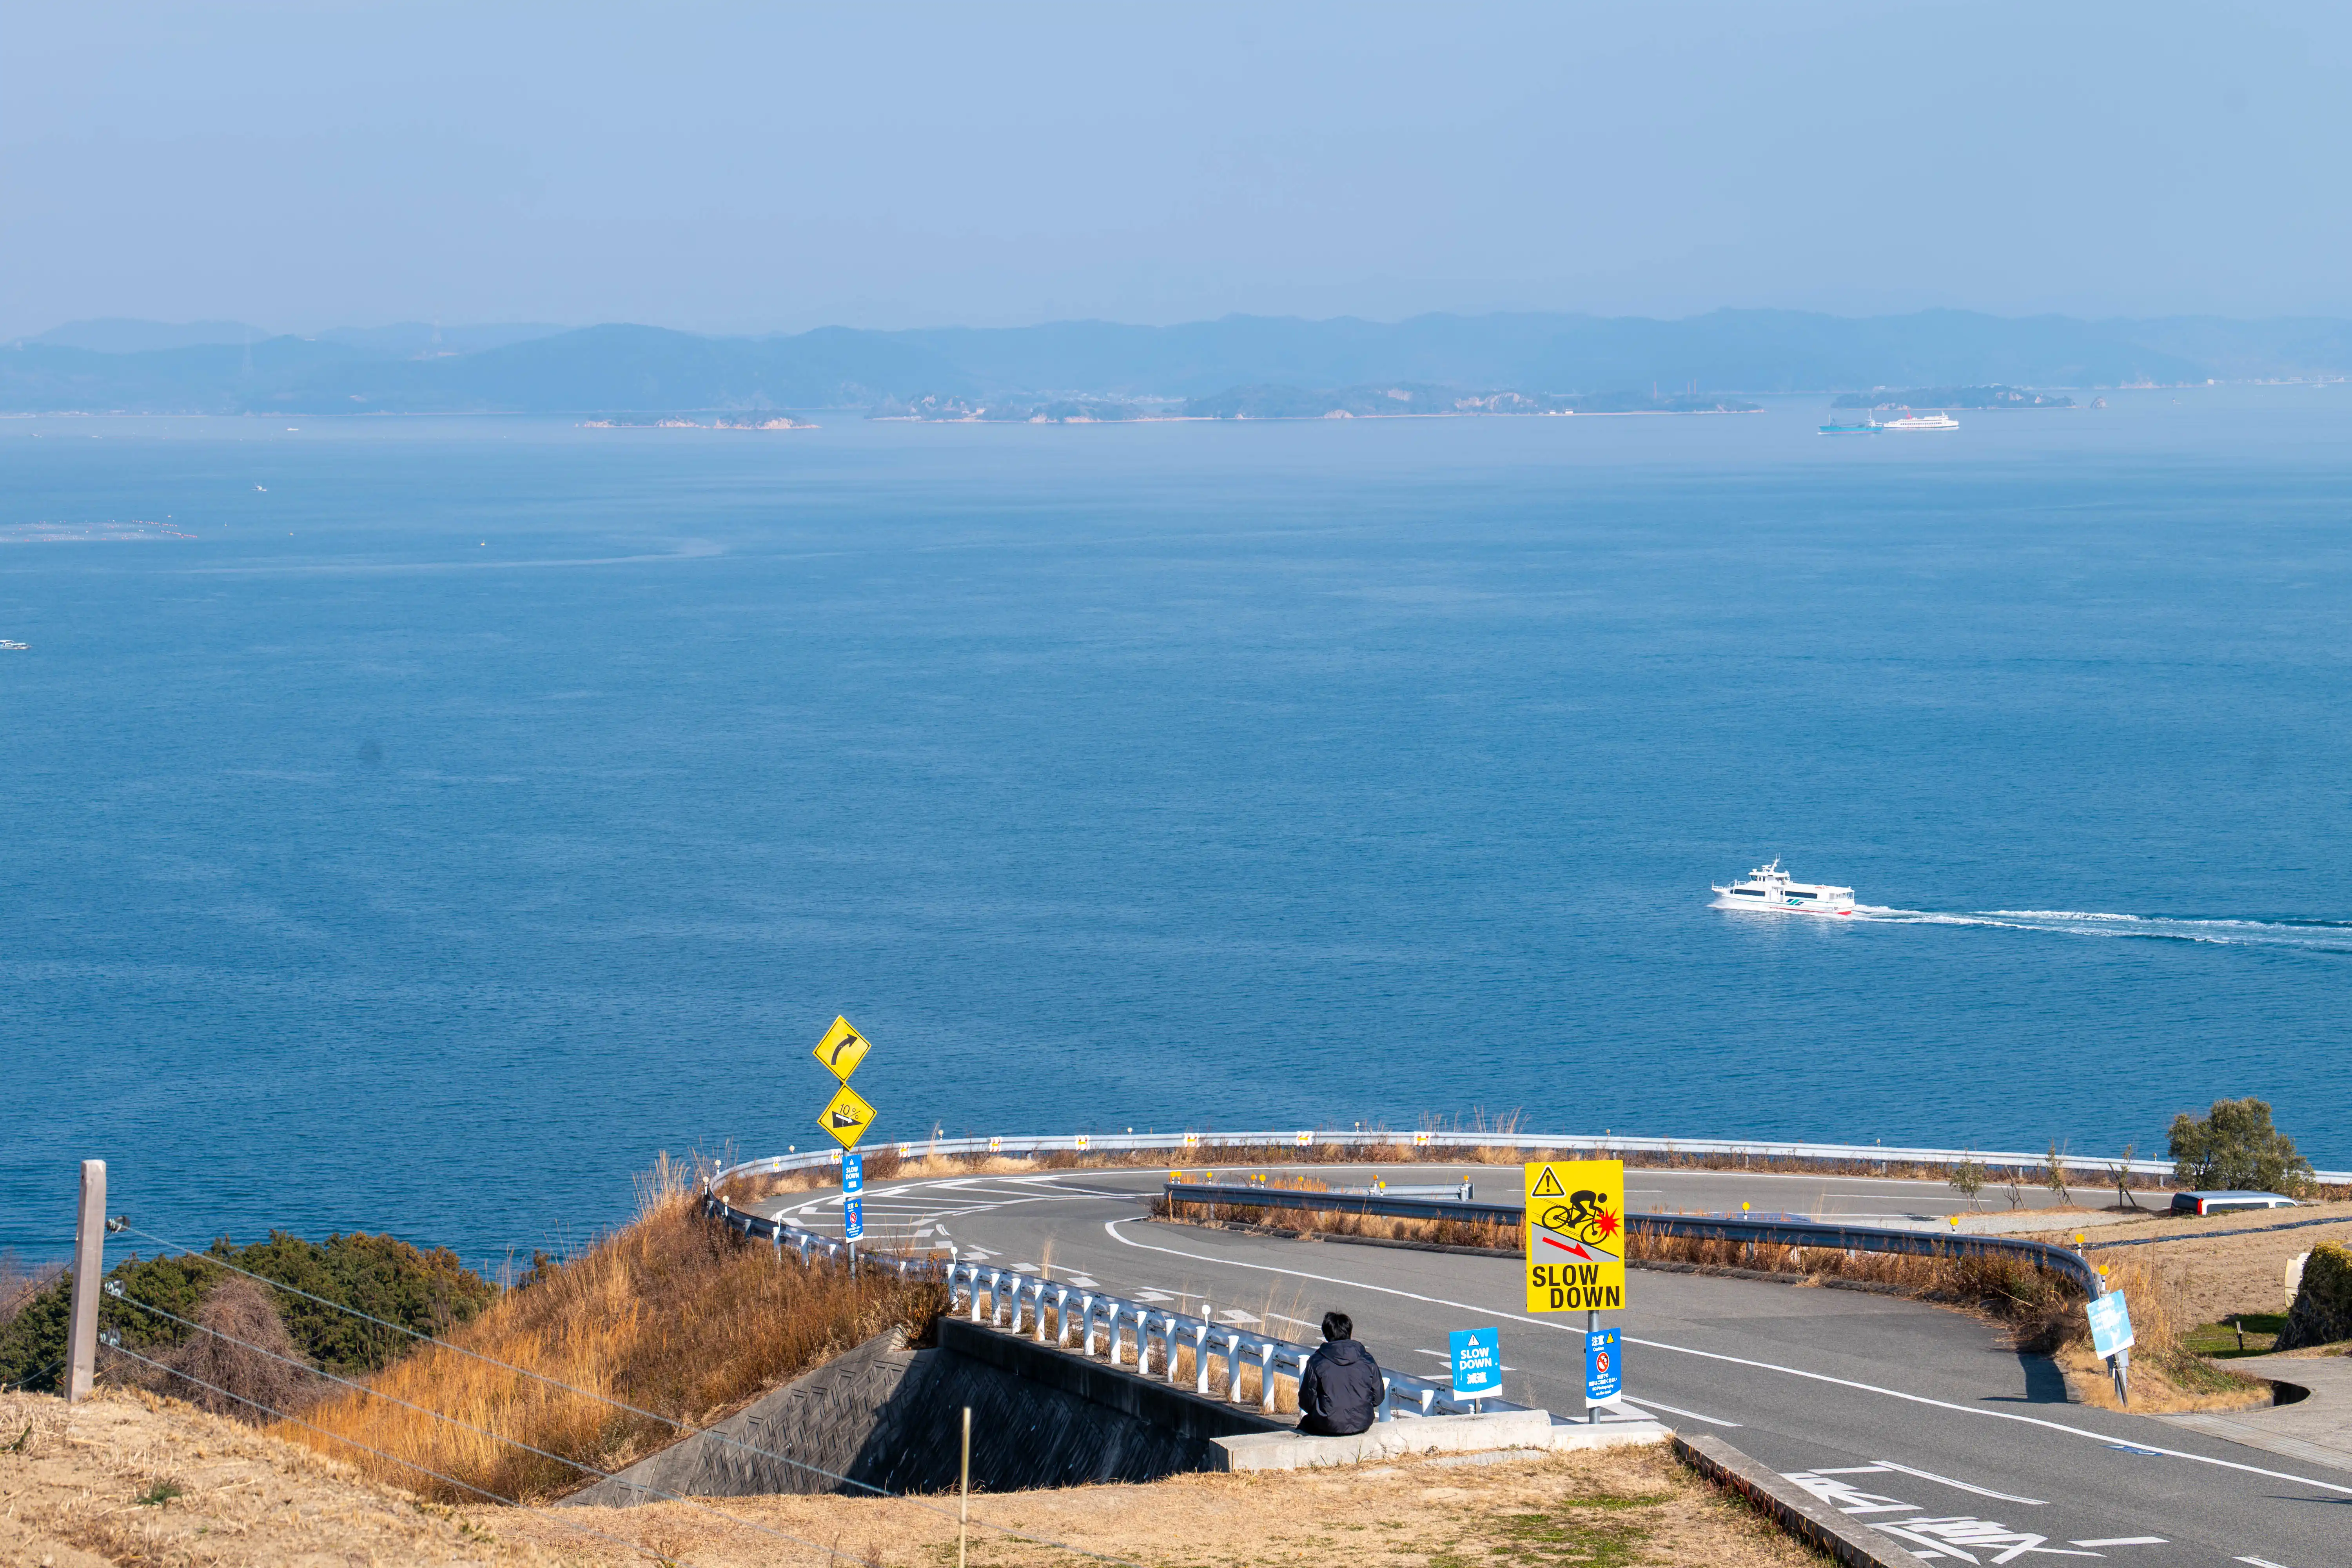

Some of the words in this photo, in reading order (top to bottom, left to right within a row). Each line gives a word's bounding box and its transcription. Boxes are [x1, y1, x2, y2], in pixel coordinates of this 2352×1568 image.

[840, 1104, 860, 1119] 10%
[1533, 1265, 1599, 1287] SLOW
[1550, 1286, 1620, 1308] DOWN
[1592, 1335, 1604, 1346] 注意
[1461, 1347, 1489, 1359] SLOW
[1459, 1357, 1492, 1370] DOWN
